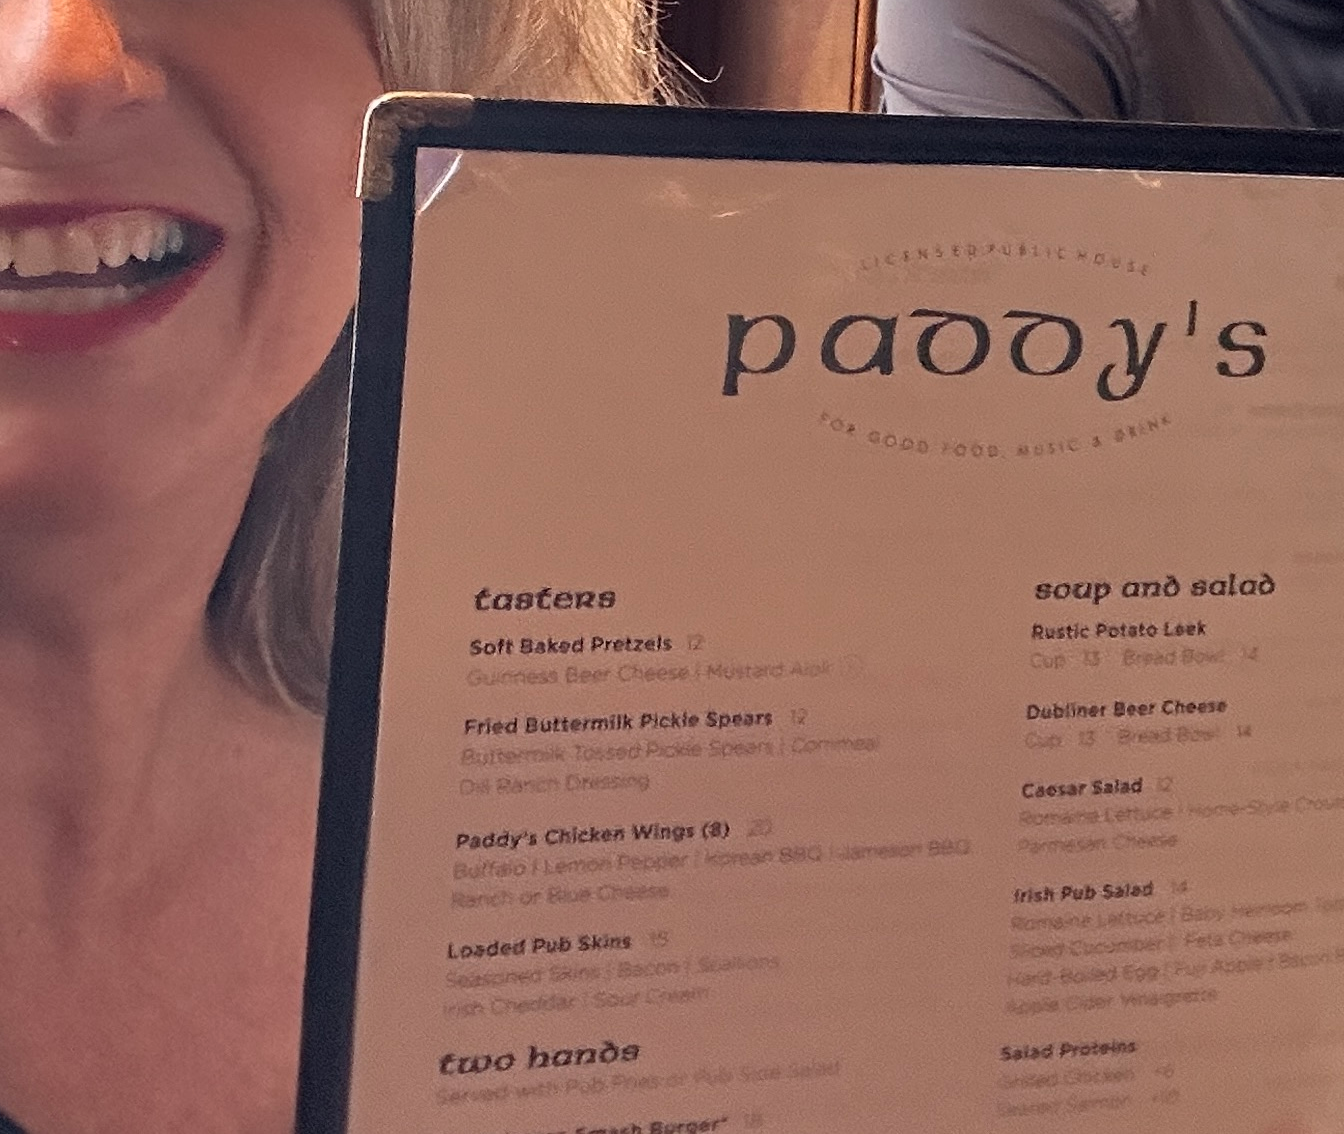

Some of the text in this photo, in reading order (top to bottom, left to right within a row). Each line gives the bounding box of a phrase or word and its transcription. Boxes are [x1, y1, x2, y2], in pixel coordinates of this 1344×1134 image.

[860, 241, 1150, 277] LICENSED PUBLIC HOUSE
[721, 298, 1269, 403] paddy's
[819, 410, 856, 436] FOR
[867, 429, 930, 455] GOOD
[1015, 436, 1082, 457] MUSIC
[1091, 434, 1103, 449] &
[1113, 412, 1172, 443] DRINK
[473, 586, 617, 612] tasters
[1033, 572, 1277, 606] soup and salad
[1030, 619, 1208, 640] Rustic Potato Leek
[469, 632, 705, 657] Soft Baked Pretzels 12
[1030, 652, 1066, 669] Cup
[1083, 649, 1101, 666] 13
[1122, 648, 1177, 666] Bread
[1181, 646, 1226, 664] Bowl
[466, 668, 559, 687] Guinness
[565, 665, 611, 684] Beer
[617, 663, 690, 682] Cheese
[706, 661, 785, 680] Mustard
[463, 707, 807, 735] Fried Buttermilk Pickle Spears 12
[1025, 698, 1228, 720] Dubliner Beer Cheese
[1024, 731, 1063, 749] Cup
[1078, 729, 1096, 747] 13
[1117, 726, 1172, 745] Bread
[1176, 725, 1221, 743] Bowl
[461, 746, 565, 765] Buttermilk
[574, 743, 642, 761] Tossed
[645, 740, 703, 758] Pickle
[708, 738, 774, 758] Spears
[496, 776, 560, 794] Ranch
[564, 773, 651, 793] Dressing
[1020, 775, 1174, 799] Caesar Salad 12
[1019, 809, 1100, 826] Romaine
[1104, 806, 1174, 824] Lettuce
[455, 817, 773, 850] Paddy's Chicken Wings (8) 20
[1017, 833, 1179, 855] Parmesan Cheese
[453, 859, 527, 880] Buffalo
[544, 858, 613, 876] Lemon
[617, 853, 689, 872] Pepper
[778, 845, 823, 864] BBQ
[927, 837, 972, 856] BBQ
[451, 883, 670, 909] Ranch or Blue Cheese
[1013, 885, 1055, 904] Irish
[1060, 883, 1097, 902] Pub
[1102, 880, 1155, 900] Salad
[1096, 911, 1165, 929] Lettuce
[1181, 904, 1225, 923] Baby
[445, 938, 527, 960] Loaded
[530, 935, 573, 955] Pub
[576, 933, 633, 952] Skins
[445, 968, 543, 988] Seasoned
[549, 964, 601, 983] Skins
[617, 960, 680, 979] Bacon
[1121, 964, 1161, 983] Egg
[490, 994, 576, 1015] Cheddar
[593, 990, 641, 1009] Sour
[438, 1038, 642, 1076] two hands
[999, 1038, 1139, 1062] Salad Proteins
[565, 1076, 606, 1095] Pub
[692, 1066, 734, 1086] Pub
